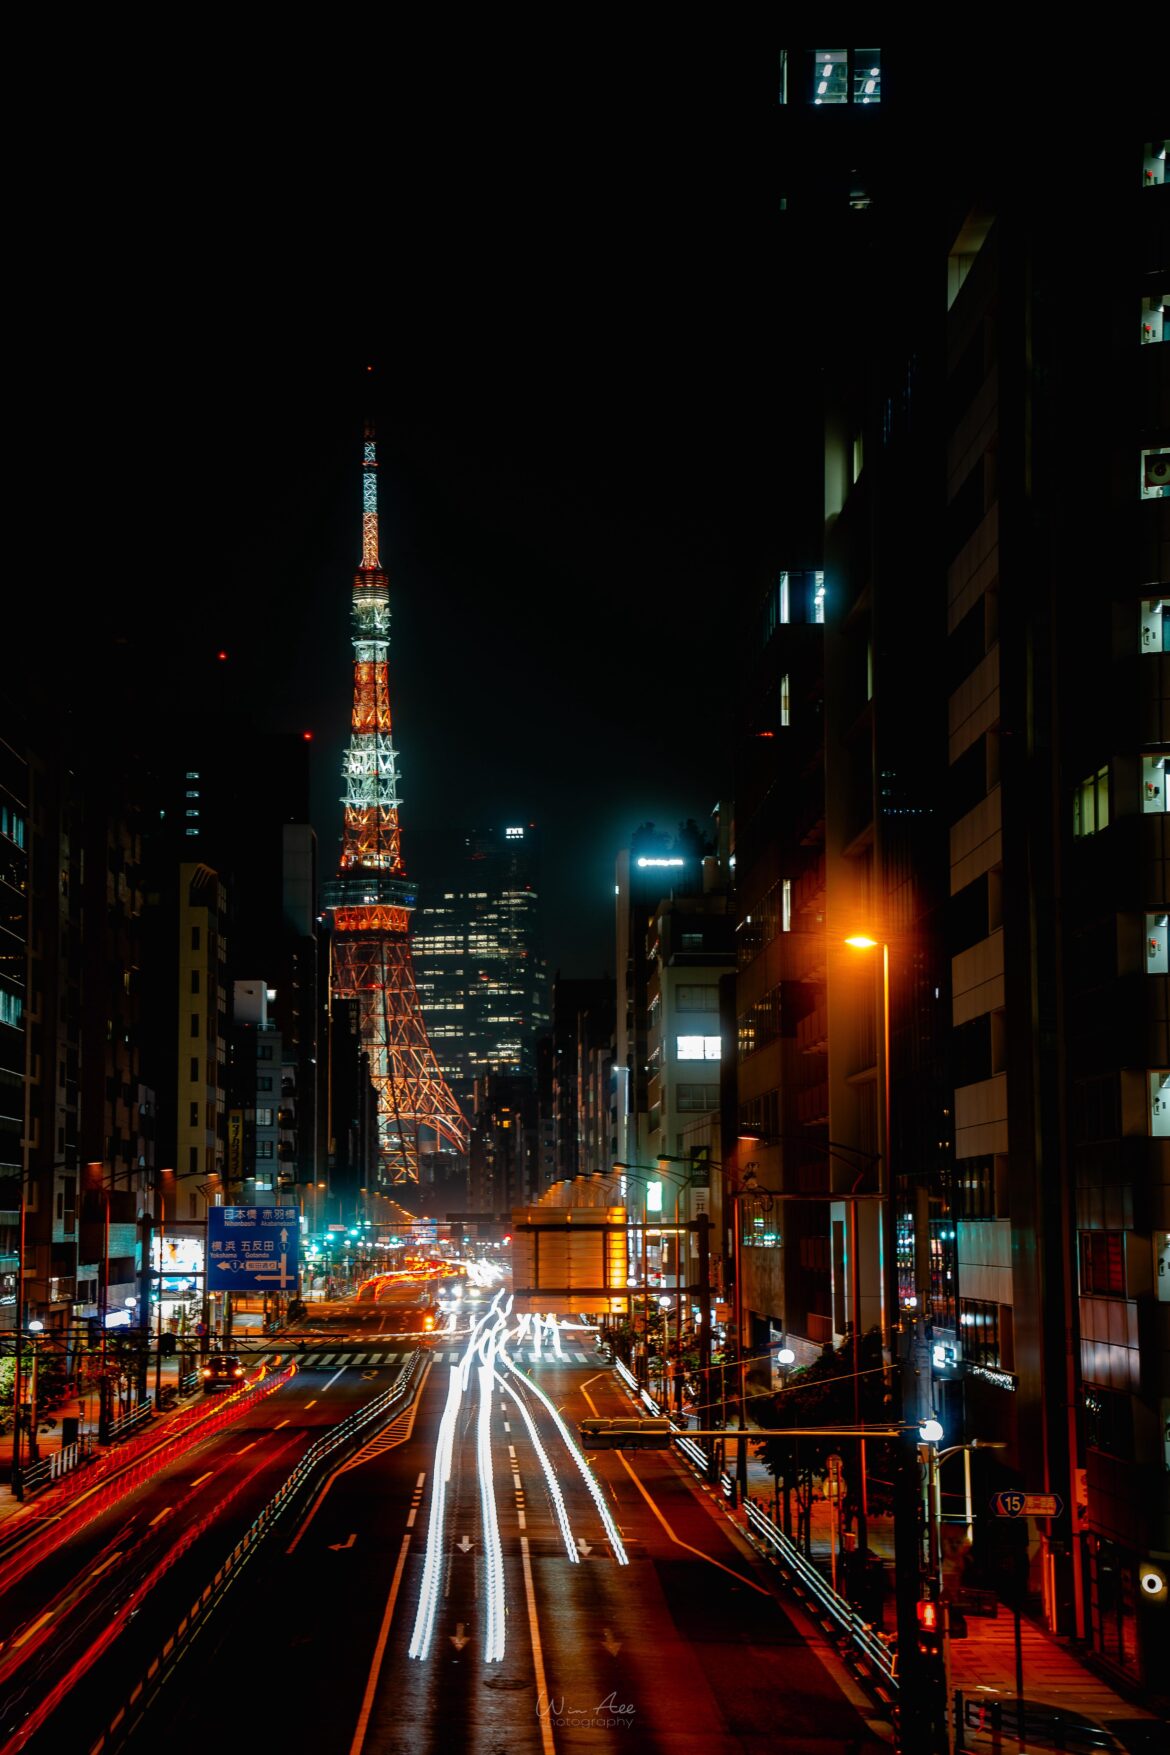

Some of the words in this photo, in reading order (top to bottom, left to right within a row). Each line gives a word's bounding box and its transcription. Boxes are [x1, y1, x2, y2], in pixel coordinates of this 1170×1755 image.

[224, 1209, 257, 1220] 日本橋
[262, 1209, 296, 1220] 赤羽橋
[212, 1240, 236, 1251] 横浜
[241, 1240, 274, 1251] 五反田
[1005, 1496, 1020, 1511] 15
